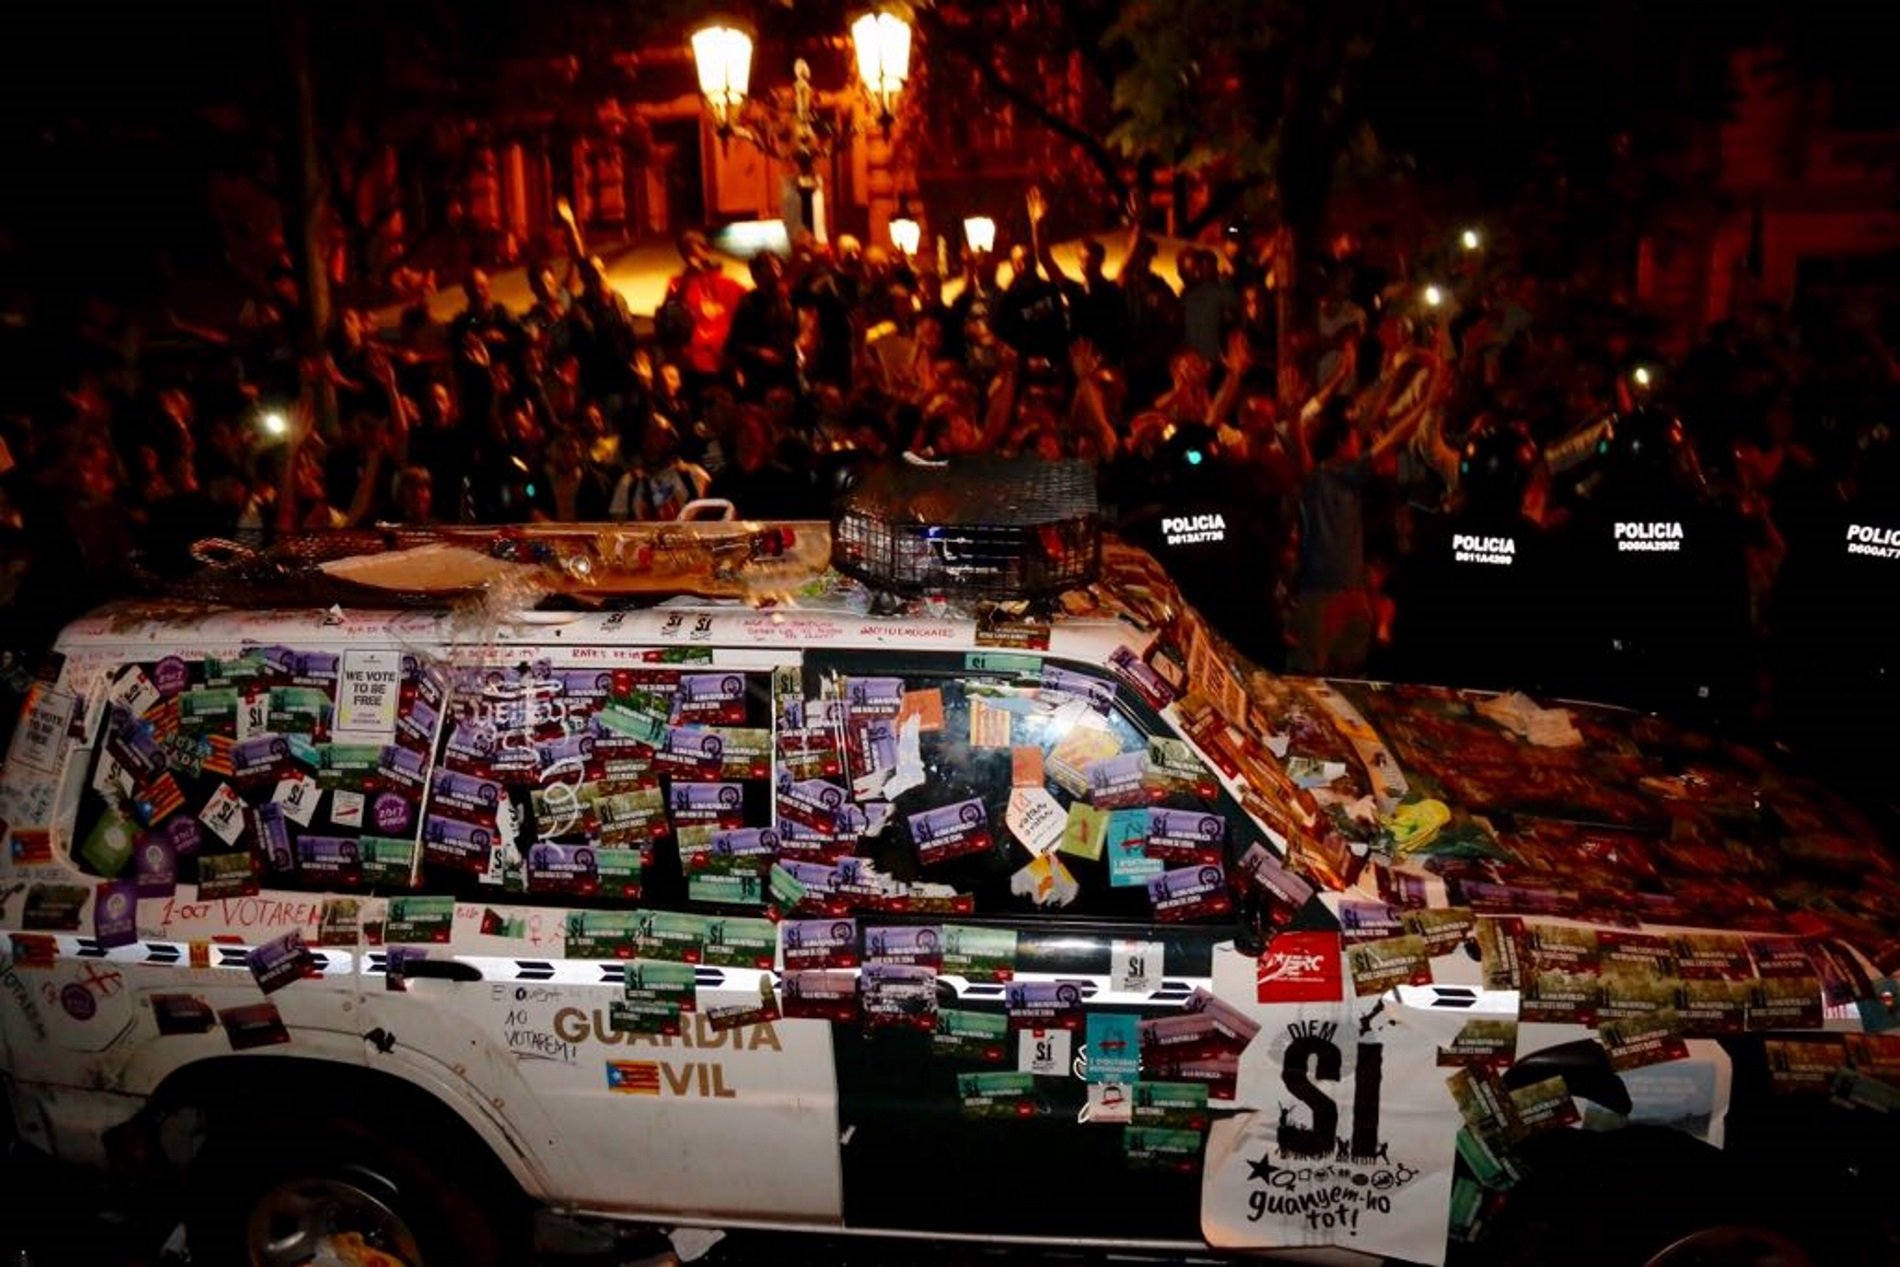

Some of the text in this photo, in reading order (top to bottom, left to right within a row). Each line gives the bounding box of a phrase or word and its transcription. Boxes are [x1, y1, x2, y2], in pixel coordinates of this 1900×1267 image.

[1162, 514, 1226, 534] POLICIA
[1615, 522, 1684, 540] POLICIA
[1452, 534, 1516, 555] POLICIA
[346, 671, 396, 682] WE VOTE
[352, 683, 386, 694] TO BE
[353, 696, 383, 706] FREE
[553, 1006, 782, 1051] GURDIA
[1287, 1020, 1338, 1041] DIEM
[1247, 1186, 1391, 1222] guanyem-ho
[1306, 1208, 1359, 1236] tot!
